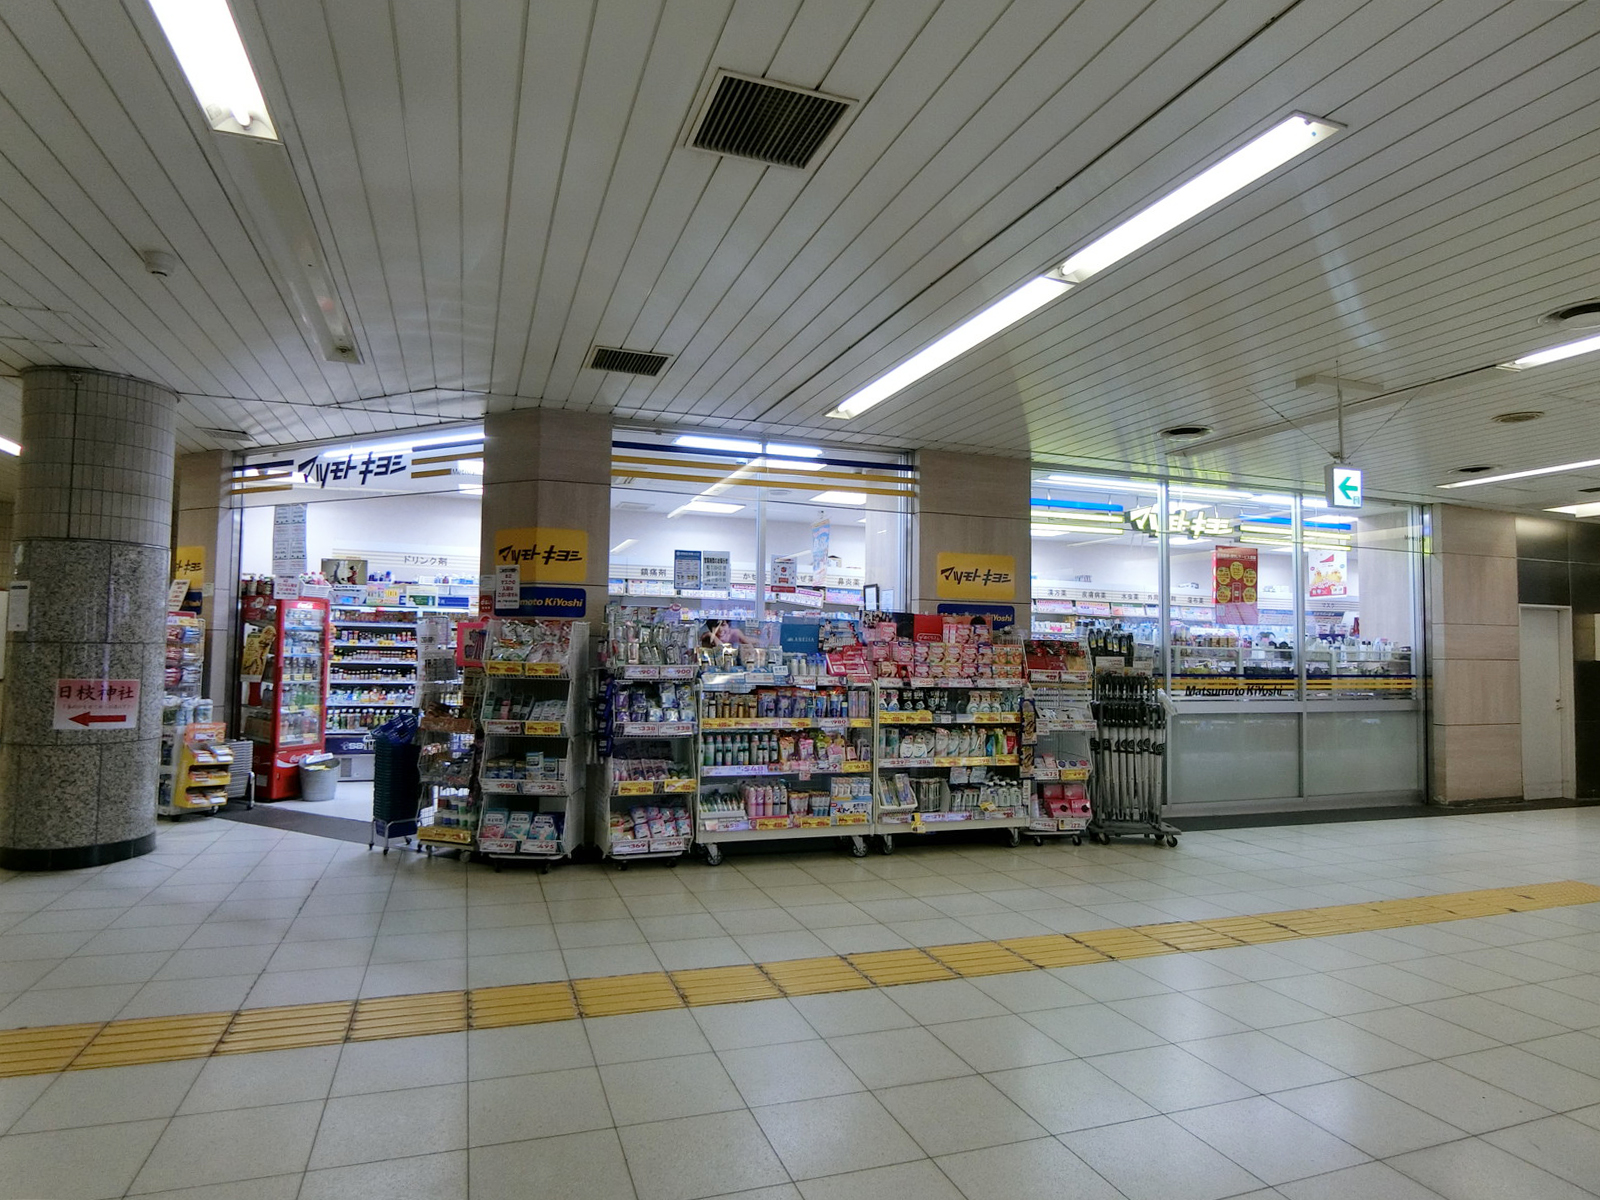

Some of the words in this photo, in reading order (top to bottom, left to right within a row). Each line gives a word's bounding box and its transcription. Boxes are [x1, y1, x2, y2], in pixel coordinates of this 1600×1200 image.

[403, 555, 448, 566] ドリンク剤
[498, 544, 583, 565] マツモトキヨシ
[940, 566, 1012, 586] マツモトキヨシ
[60, 685, 134, 701] 日枝神社
[1185, 685, 1245, 697] Matsumoto
